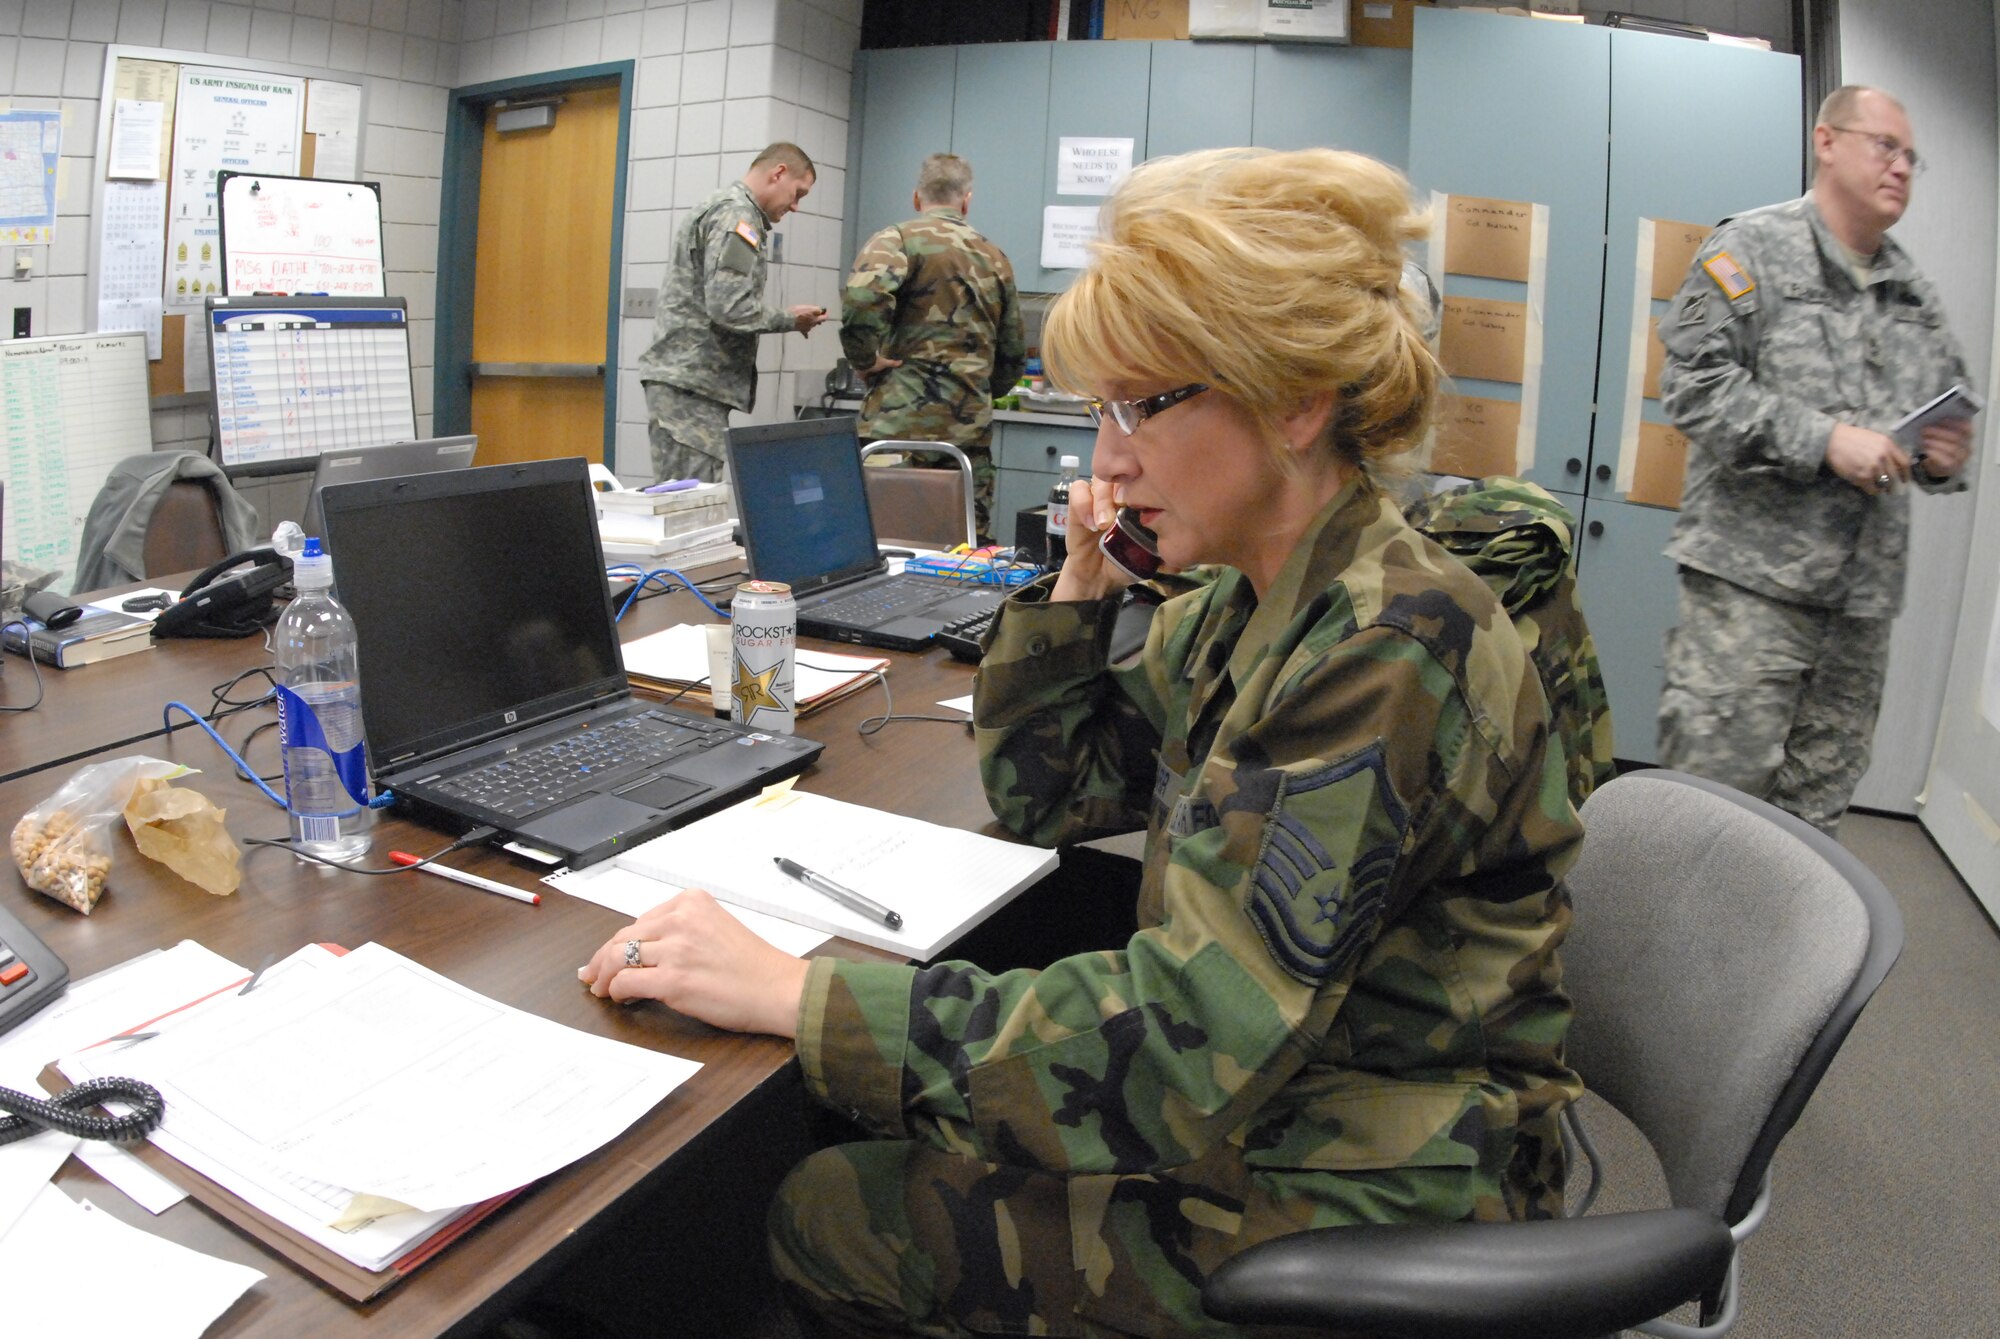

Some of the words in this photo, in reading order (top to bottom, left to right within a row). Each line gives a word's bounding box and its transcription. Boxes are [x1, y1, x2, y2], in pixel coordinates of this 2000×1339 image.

[190, 77, 200, 85] US
[201, 79, 224, 87] ARMY
[225, 81, 259, 91] INSIGNIA
[261, 84, 271, 93] OF
[272, 86, 293, 95] RANK
[213, 96, 239, 104] GENERAL
[240, 98, 267, 106] OFFICERS
[1072, 147, 1096, 157] WHO
[1098, 149, 1120, 157] ELSE
[1072, 162, 1103, 170] NEEDS
[1105, 162, 1118, 170] TO
[1077, 175, 1112, 184] KNOW?
[1456, 202, 1527, 218] Commander
[735, 636, 773, 648] SUGAR
